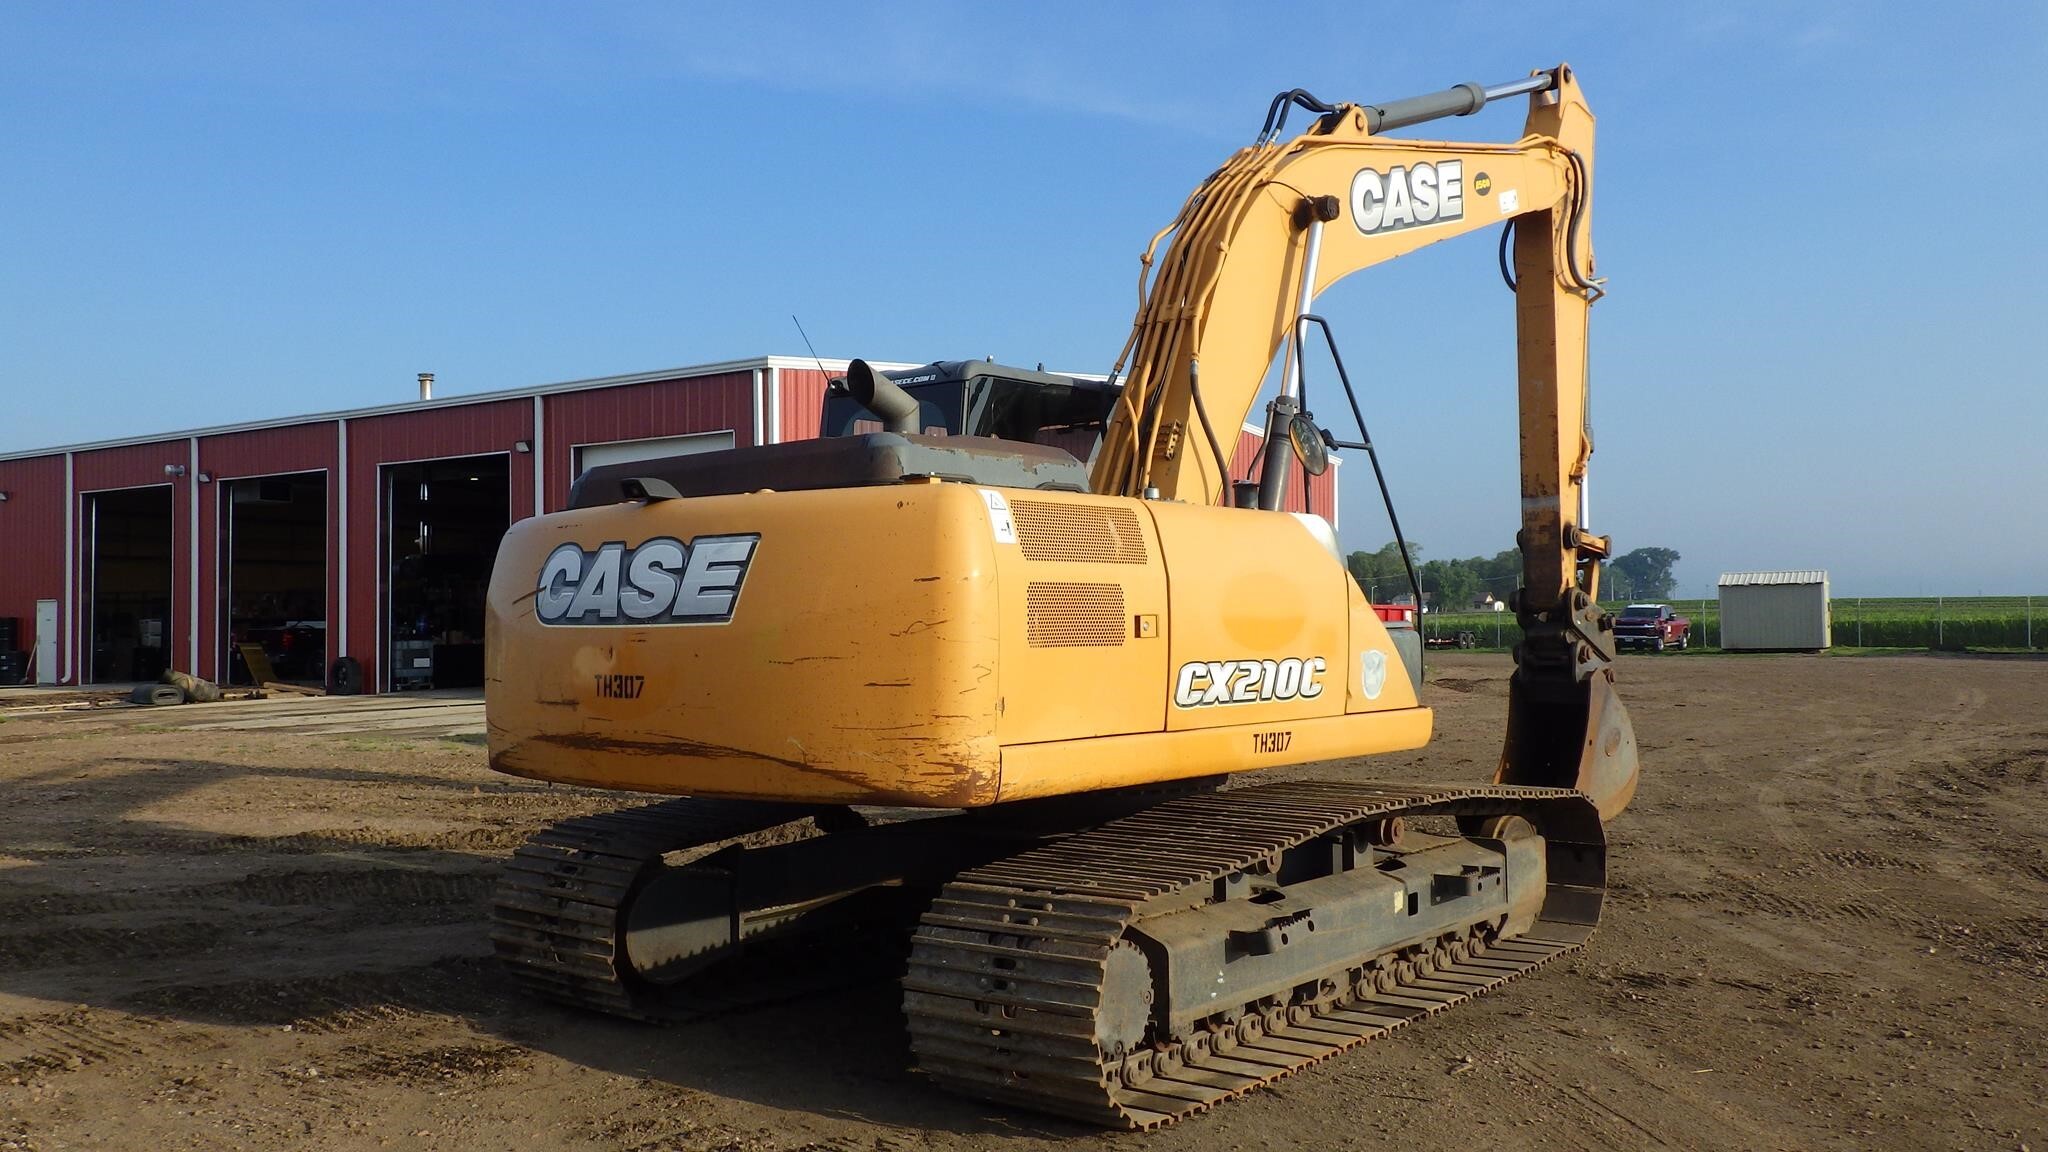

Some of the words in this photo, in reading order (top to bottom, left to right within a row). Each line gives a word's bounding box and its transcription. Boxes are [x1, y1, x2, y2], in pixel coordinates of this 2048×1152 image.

[1351, 159, 1464, 234] CASE
[536, 534, 760, 624] CASE
[594, 674, 645, 699] TH307
[1174, 656, 1327, 708] CX210C
[1253, 731, 1292, 754] TH307
